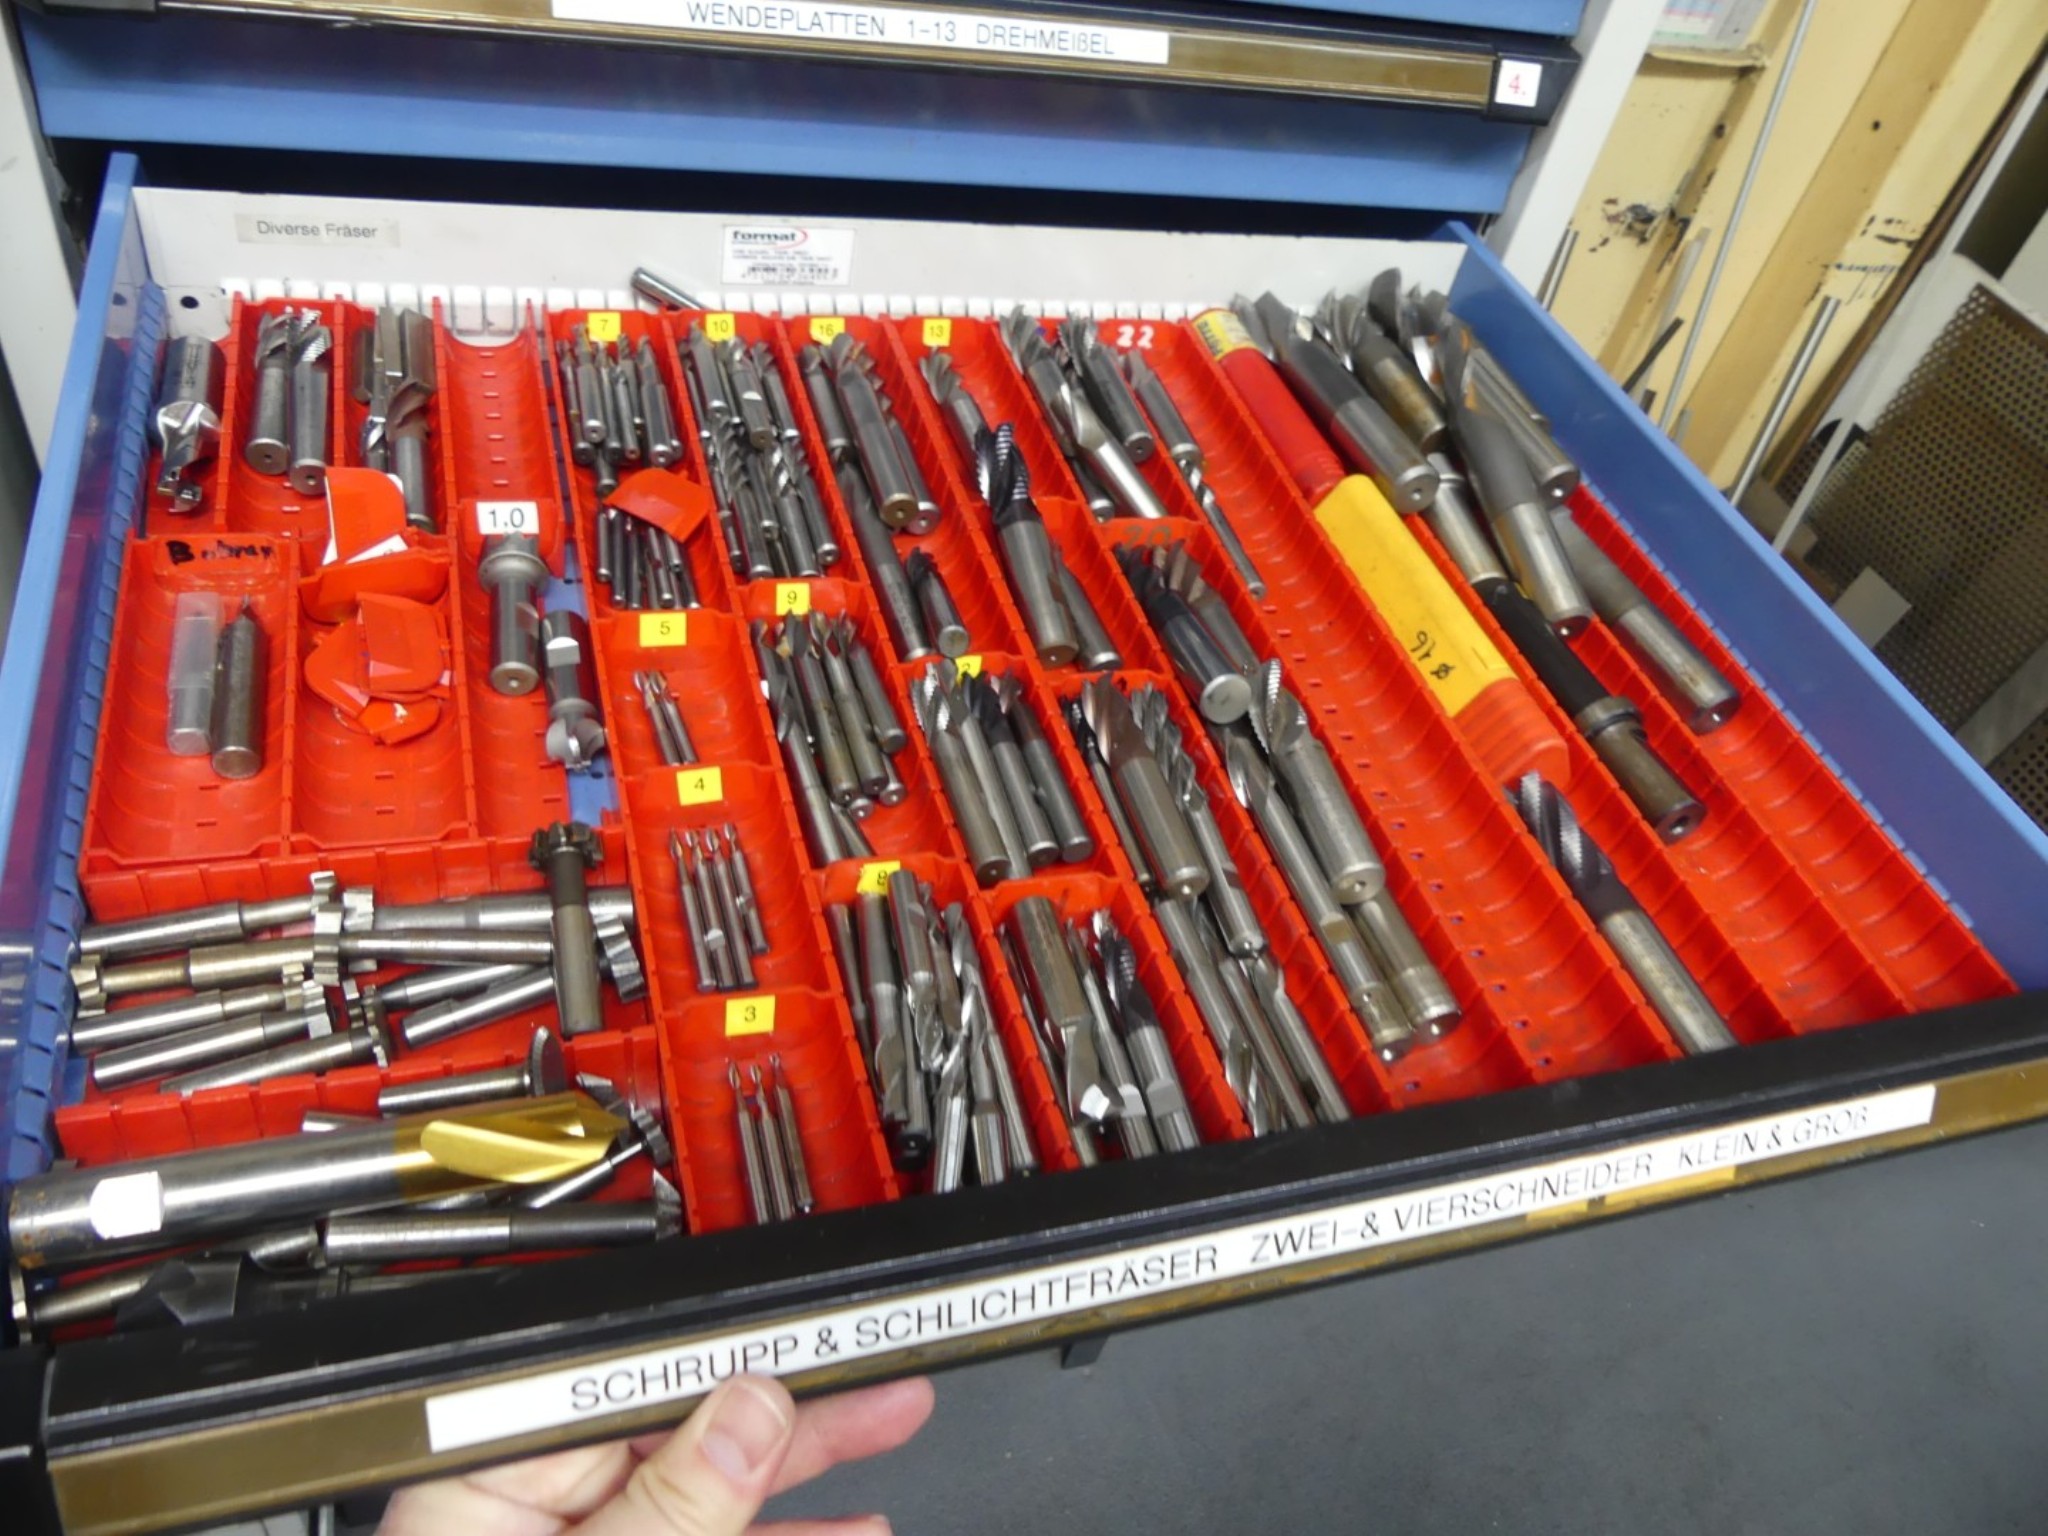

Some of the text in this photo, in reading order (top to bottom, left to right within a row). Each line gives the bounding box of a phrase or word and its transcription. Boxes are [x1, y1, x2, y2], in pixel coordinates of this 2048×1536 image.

[688, 1, 885, 36] WENDEPLATTEN
[907, 19, 957, 42] 1-13
[256, 220, 378, 238] Diverse Fräser
[600, 319, 608, 331] 7
[713, 319, 729, 333] 10
[818, 324, 834, 337] 16
[929, 325, 944, 338] 13
[488, 507, 525, 529] 1.0
[787, 590, 798, 605] 9
[659, 620, 671, 636] 5
[693, 776, 706, 792] 4
[876, 869, 888, 887] 8
[744, 1004, 756, 1023] 3
[571, 1334, 798, 1411] SCHRUPP
[814, 1326, 839, 1358] &
[855, 1244, 1218, 1349] SCHLICHTFRÄSER
[1394, 1152, 1653, 1232] VIERSCHNEIDER
[1679, 1130, 1758, 1168] KLEIN
